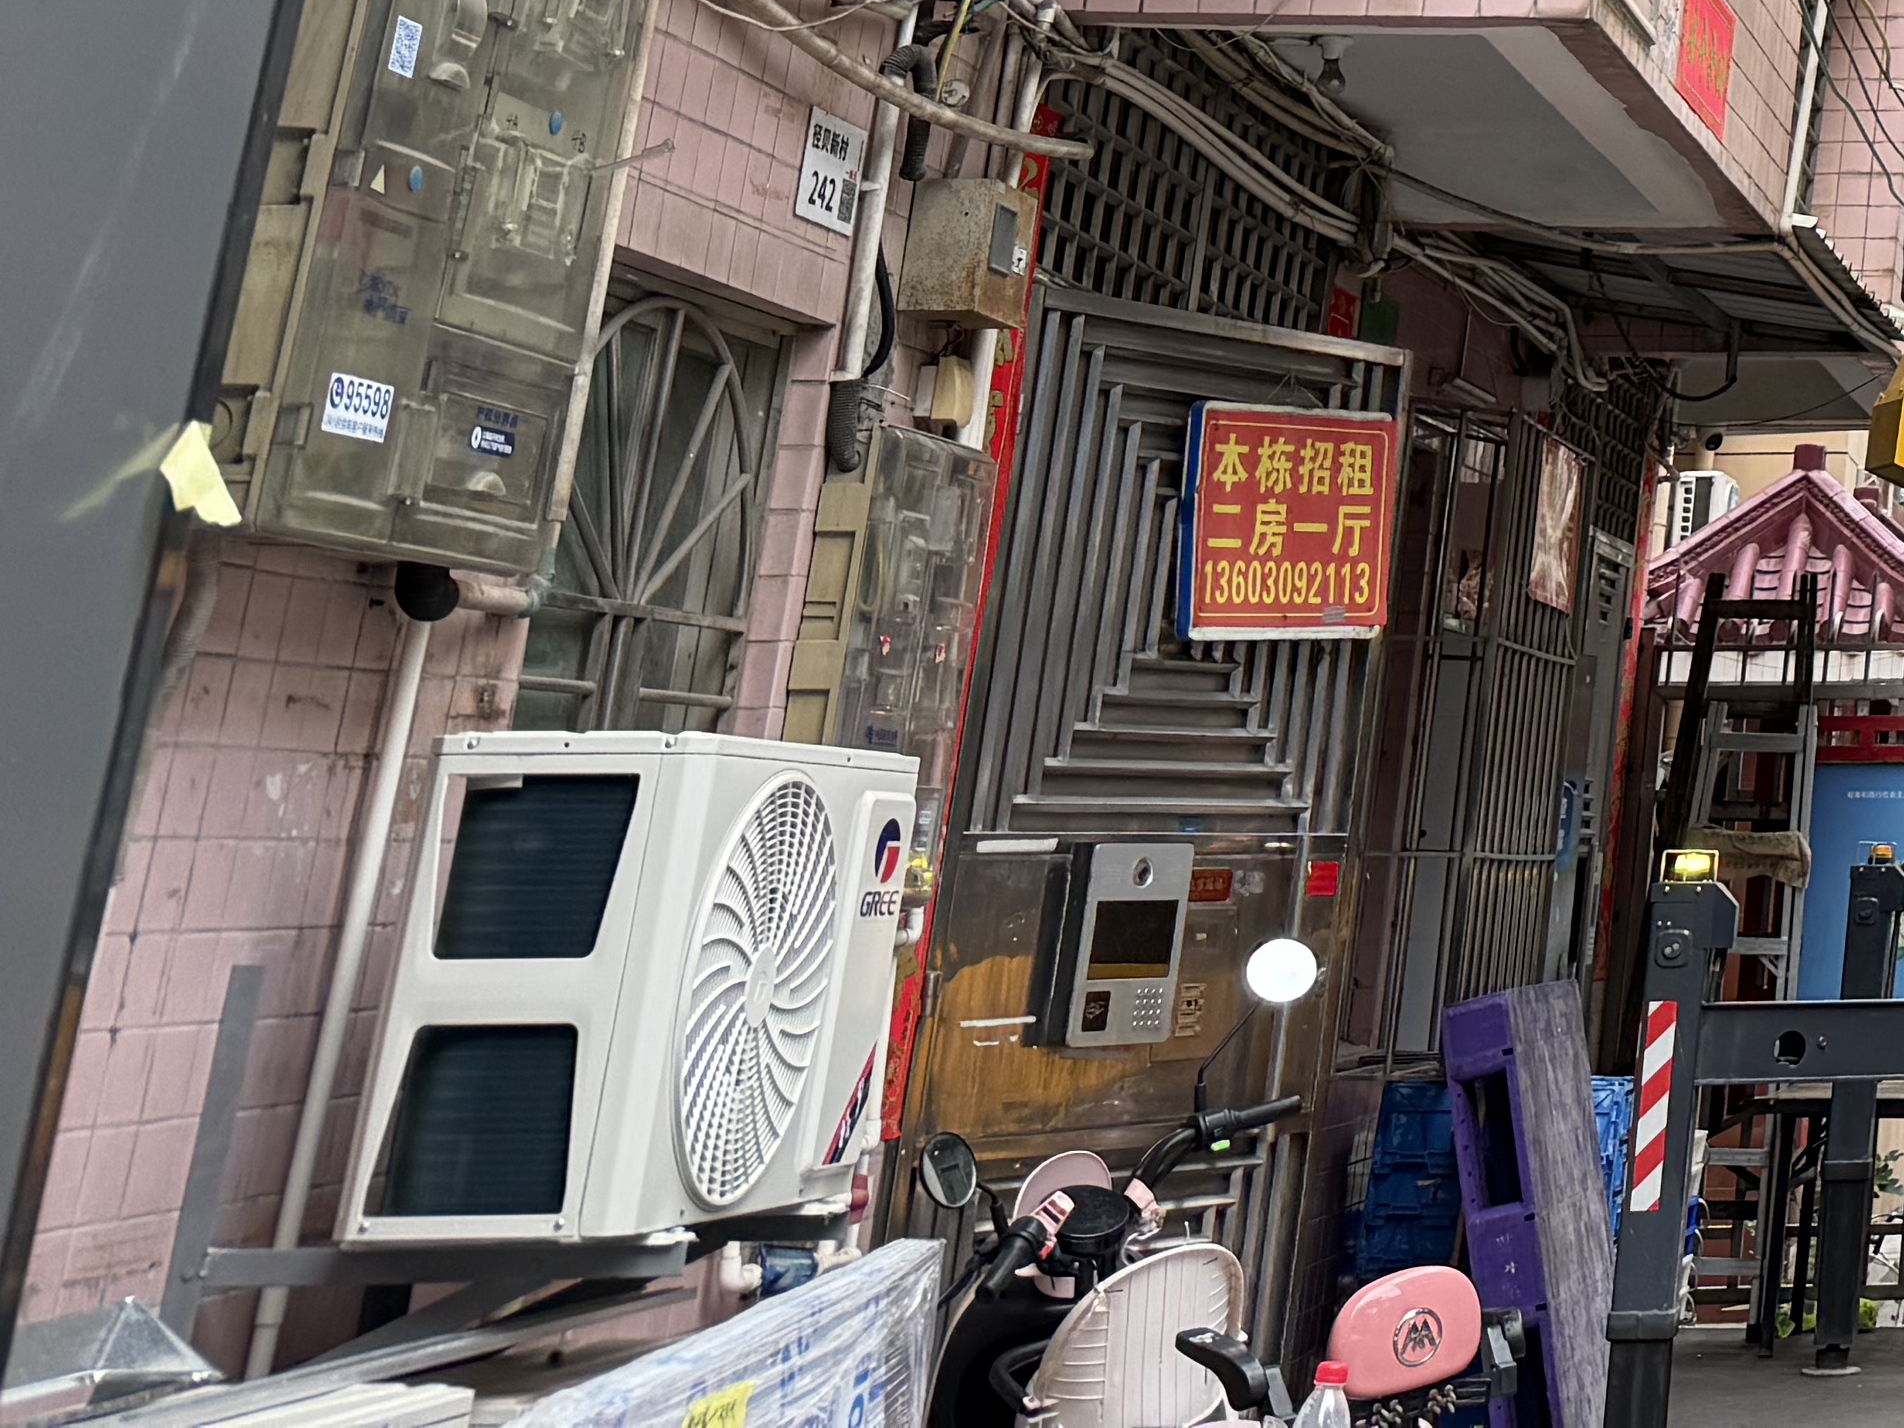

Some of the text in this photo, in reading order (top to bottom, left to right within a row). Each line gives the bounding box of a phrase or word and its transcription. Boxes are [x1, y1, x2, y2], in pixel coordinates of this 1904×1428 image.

[812, 123, 849, 162] 径贝新村
[808, 170, 836, 213] 242
[343, 380, 391, 420] 95598
[1212, 433, 1374, 496] 本栋招租
[1206, 498, 1372, 557] 二房一厅
[1204, 560, 1371, 605] 13603092113
[860, 890, 899, 917] GREE
